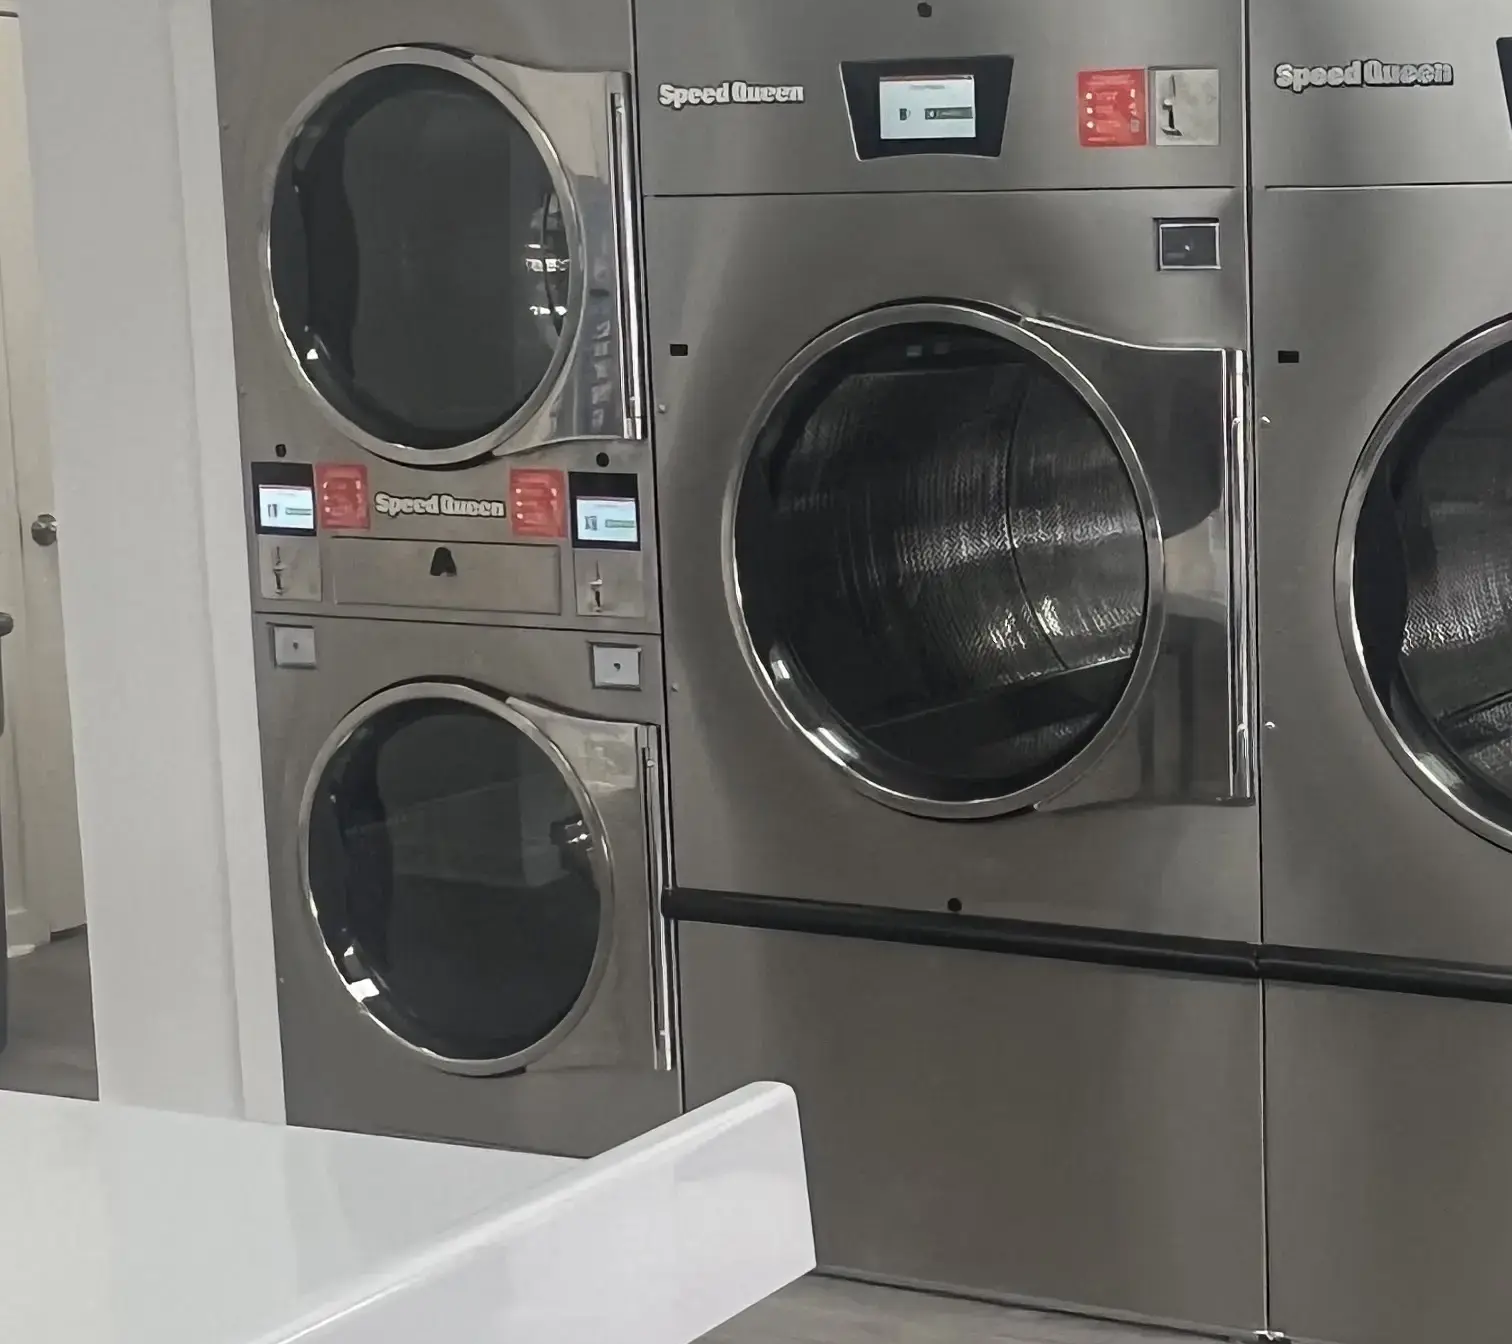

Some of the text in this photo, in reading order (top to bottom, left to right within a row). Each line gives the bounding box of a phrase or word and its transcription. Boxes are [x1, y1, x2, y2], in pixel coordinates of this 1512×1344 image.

[1275, 59, 1454, 93] Speed Queen
[658, 80, 804, 109] Speed Queen
[375, 492, 440, 517] Speed
